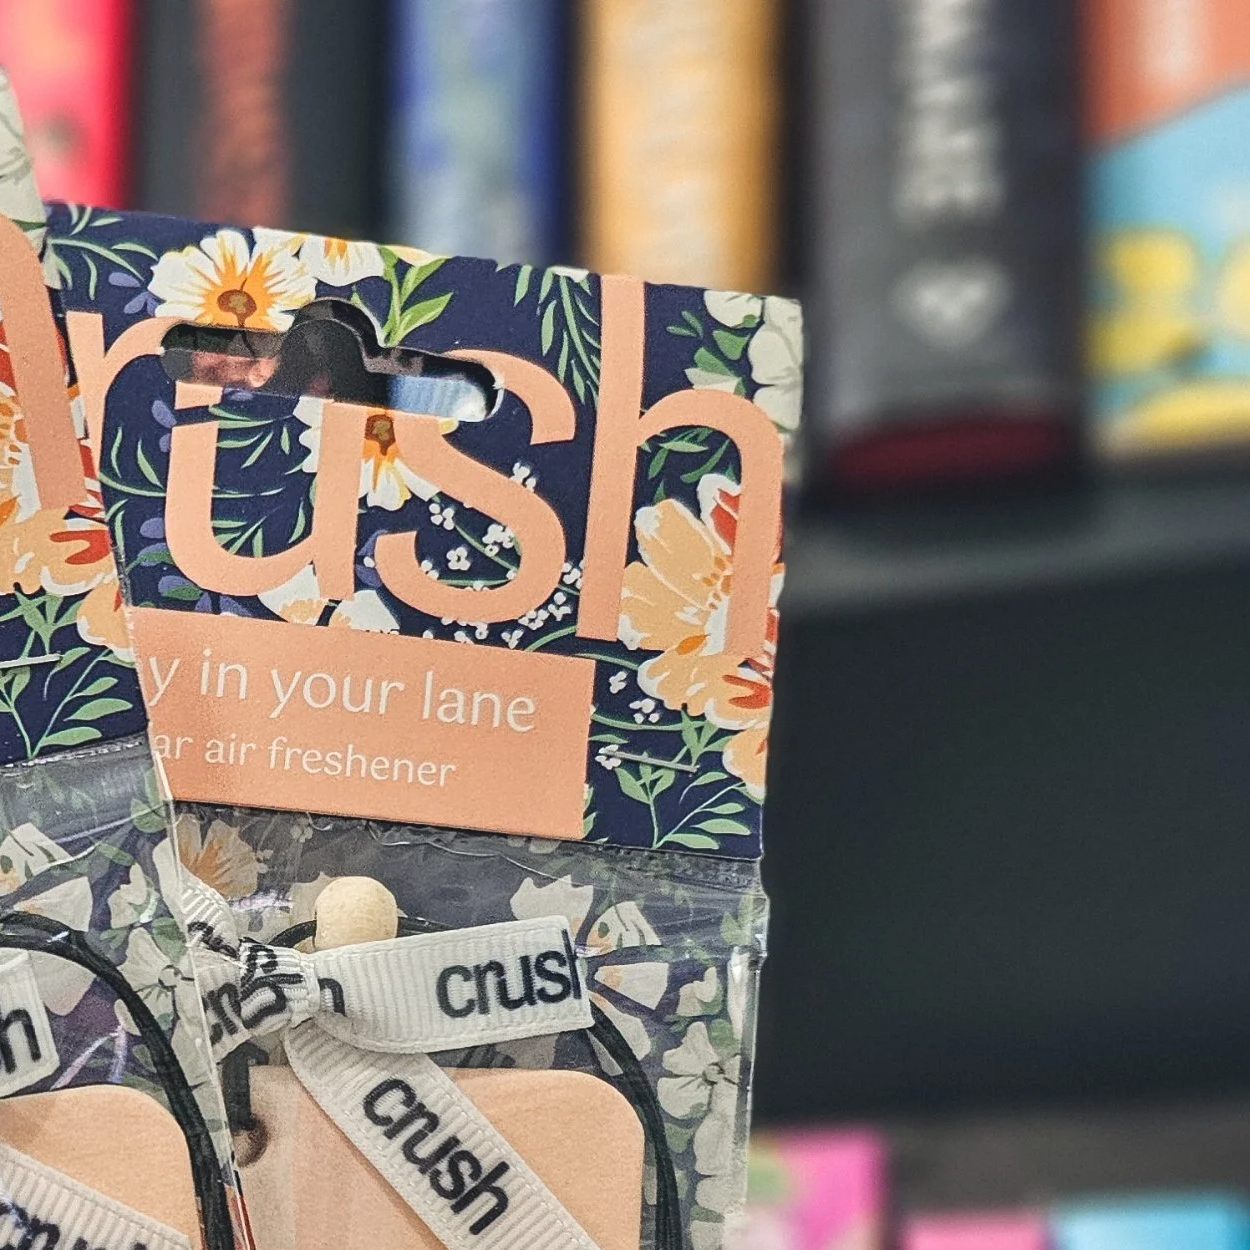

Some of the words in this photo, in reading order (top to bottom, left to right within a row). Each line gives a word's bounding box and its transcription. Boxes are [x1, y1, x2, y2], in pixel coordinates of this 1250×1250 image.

[66, 275, 784, 654] rush
[199, 649, 248, 700] in
[269, 668, 405, 719] your
[422, 670, 536, 732] lane
[152, 733, 193, 761] ar
[204, 733, 256, 766] air
[268, 736, 456, 787] freshener
[362, 1078, 510, 1236] crush
